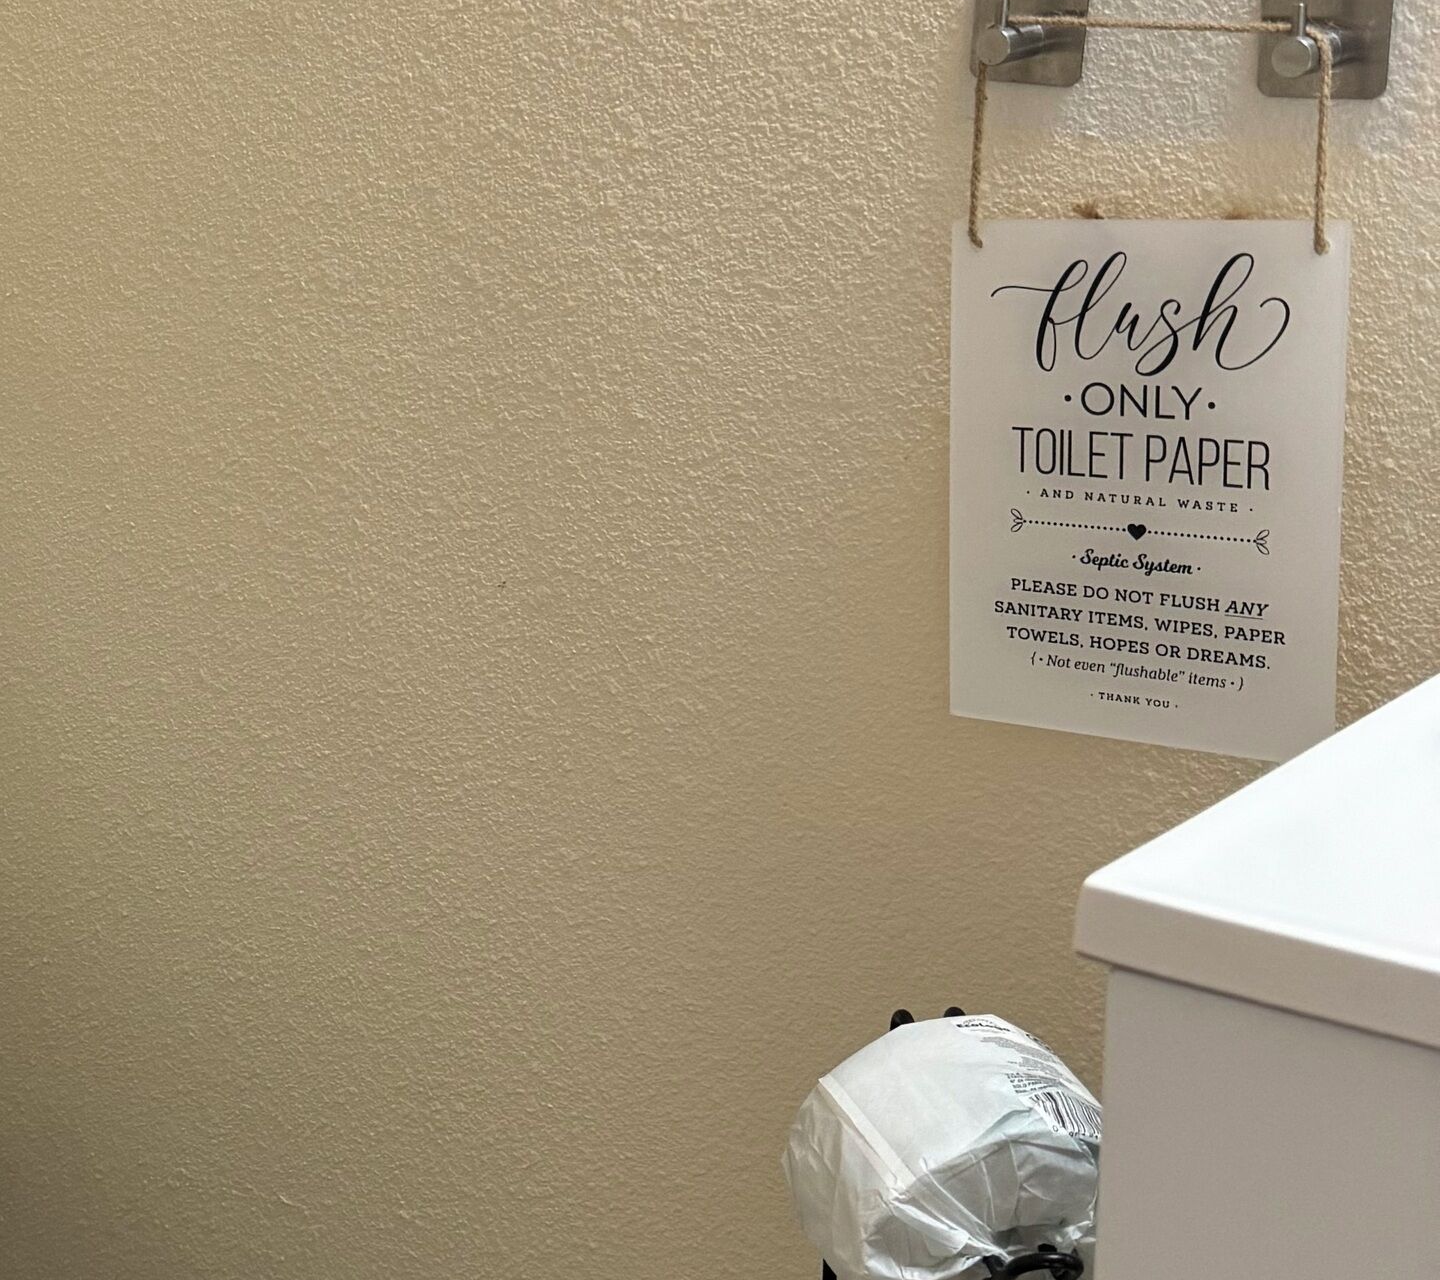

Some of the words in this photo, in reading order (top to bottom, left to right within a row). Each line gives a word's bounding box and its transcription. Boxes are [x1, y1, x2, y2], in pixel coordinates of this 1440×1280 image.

[990, 251, 1291, 377] flush
[1080, 381, 1202, 420] ONLY
[1011, 426, 1134, 480] TOILET
[1144, 434, 1271, 491] PAPER
[1039, 488, 1075, 500] AND
[1084, 491, 1167, 507] NATURAL
[1177, 498, 1239, 513] WASTE
[1079, 548, 1129, 572] Septic
[1132, 553, 1194, 577] System
[1010, 577, 1078, 597] PLEASE
[1082, 585, 1110, 600] DO
[1114, 588, 1154, 606] NOT
[1159, 593, 1221, 613] FLUSH
[1224, 600, 1270, 619] ANY
[994, 600, 1084, 622] SANITARY
[1087, 610, 1149, 631] ITEMS,
[1154, 617, 1219, 639] WIPES,
[1224, 625, 1287, 646] PAPER
[1006, 625, 1085, 649] TOWELS,
[1089, 635, 1150, 655] HOPES
[1154, 643, 1182, 659] OR
[1186, 647, 1272, 670] DREAMS.
[1046, 654, 1071, 670] Not
[1073, 659, 1106, 674] even
[1187, 671, 1227, 689] items
[1098, 691, 1141, 705] THANK
[1145, 697, 1171, 709] YOU
